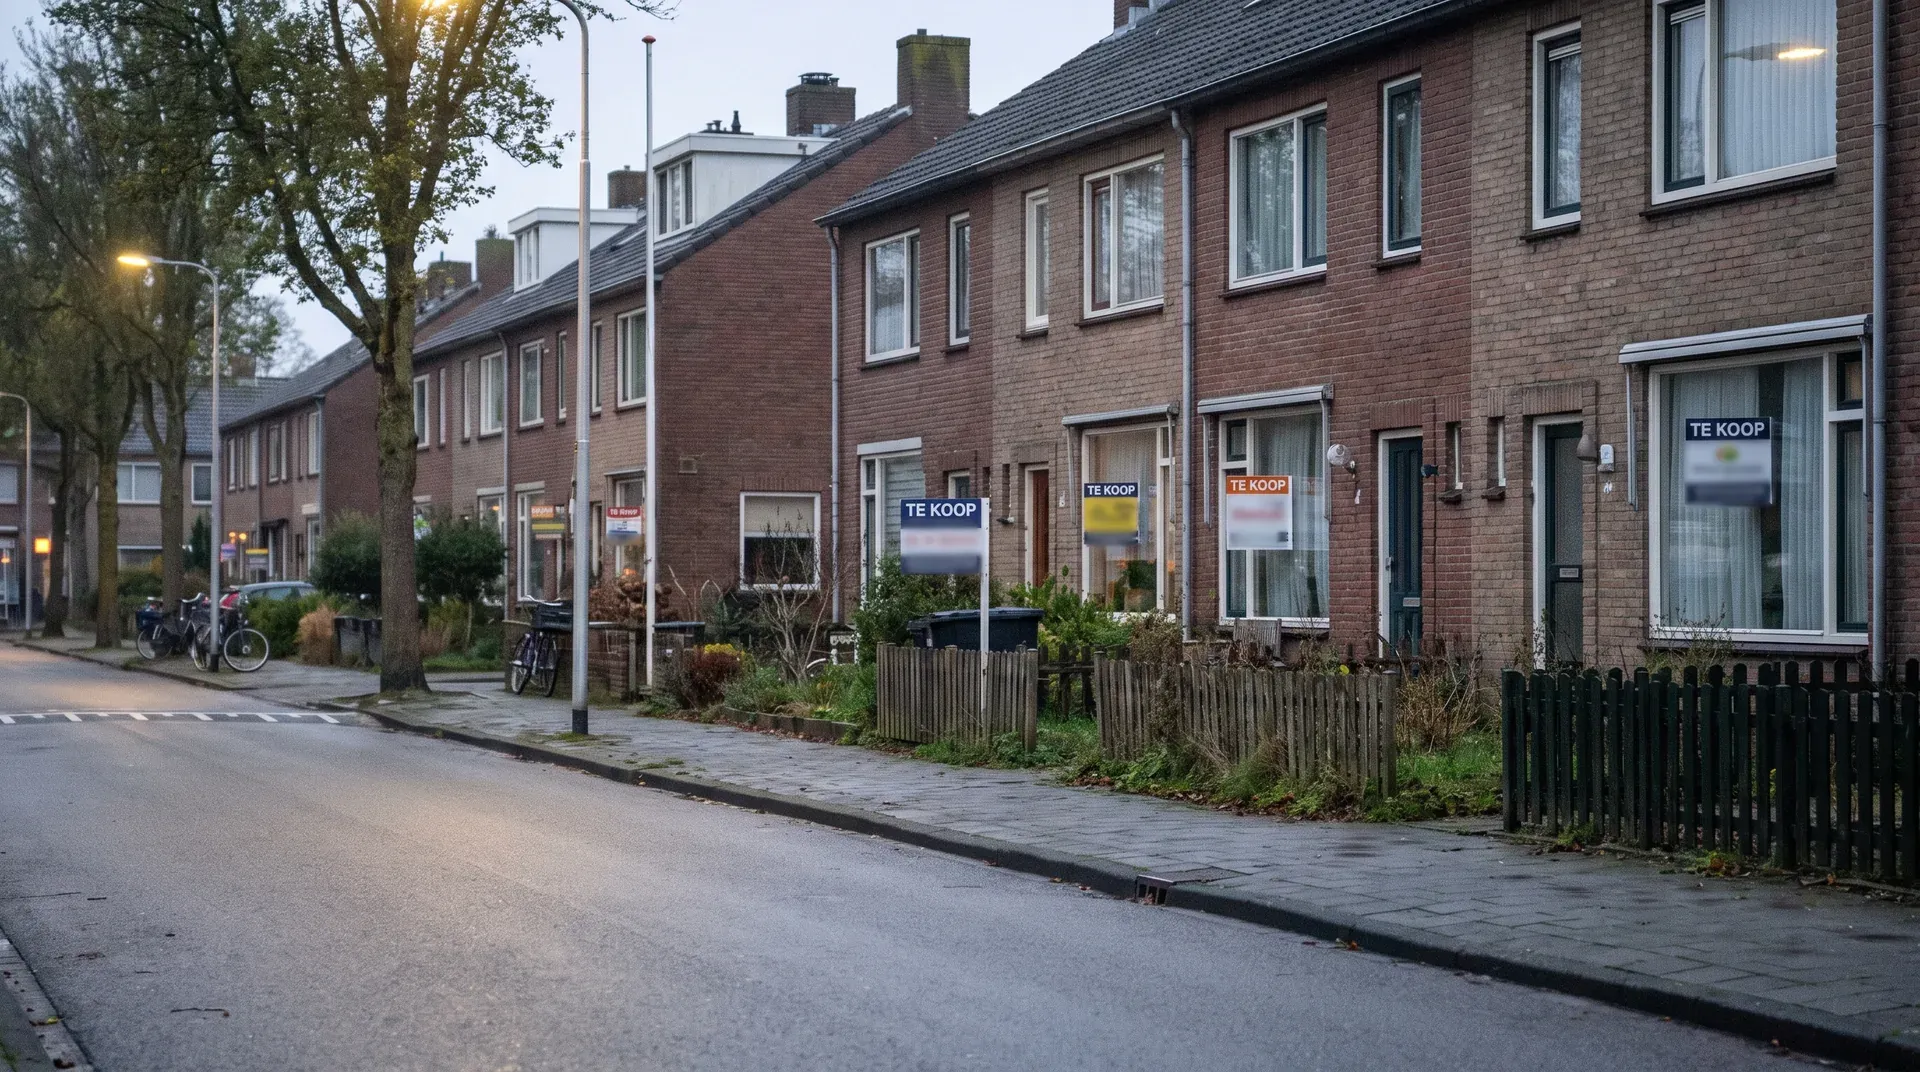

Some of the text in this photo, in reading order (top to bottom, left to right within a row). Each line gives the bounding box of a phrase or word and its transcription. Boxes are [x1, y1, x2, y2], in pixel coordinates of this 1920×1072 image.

[1690, 422, 1765, 437] TE KOOP
[1087, 485, 1136, 496] TE KOOP
[1230, 479, 1286, 491] TE KOOP
[906, 503, 977, 517] TE KOOP
